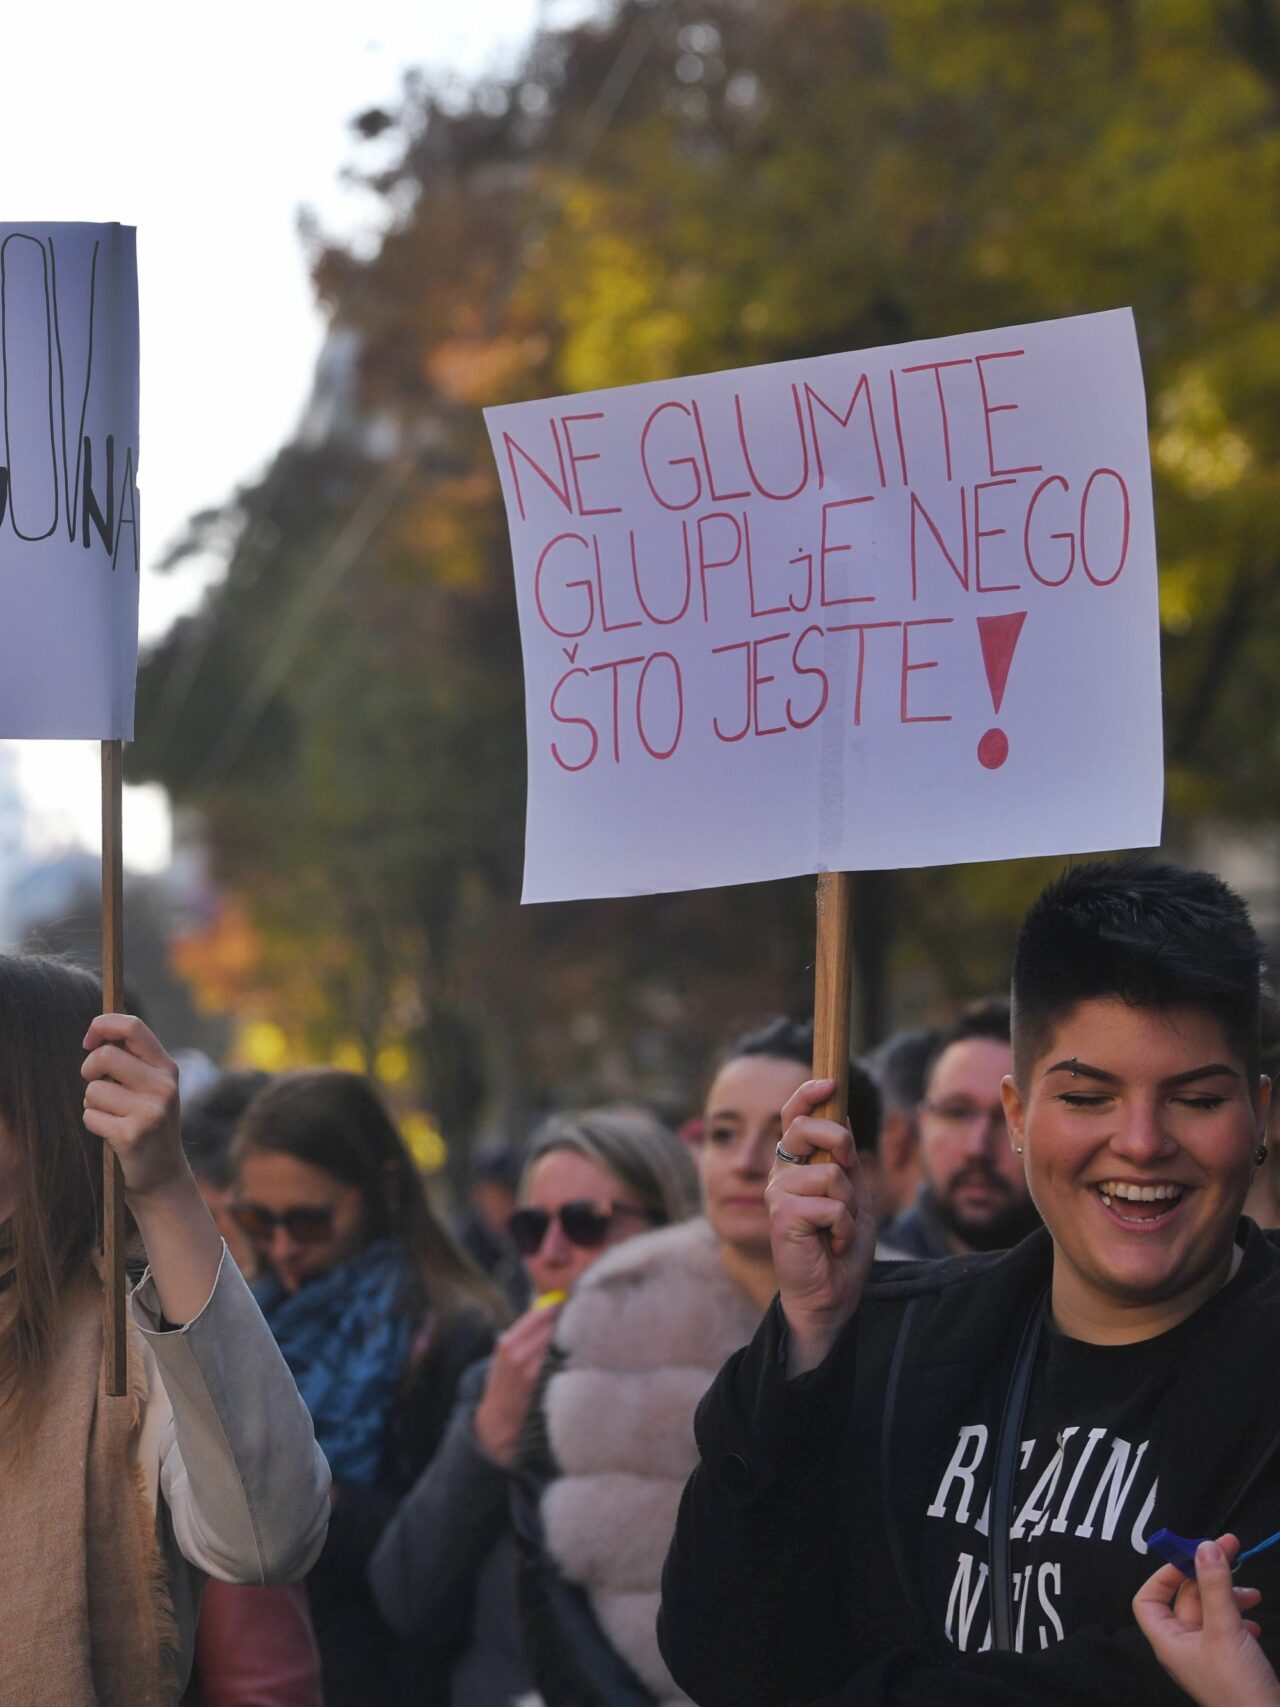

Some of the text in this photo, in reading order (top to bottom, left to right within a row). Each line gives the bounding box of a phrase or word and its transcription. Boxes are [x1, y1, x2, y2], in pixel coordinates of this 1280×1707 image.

[502, 350, 1043, 522] NE GLUMITE
[910, 467, 1131, 601] NEGO
[549, 642, 684, 772] ŠTO
